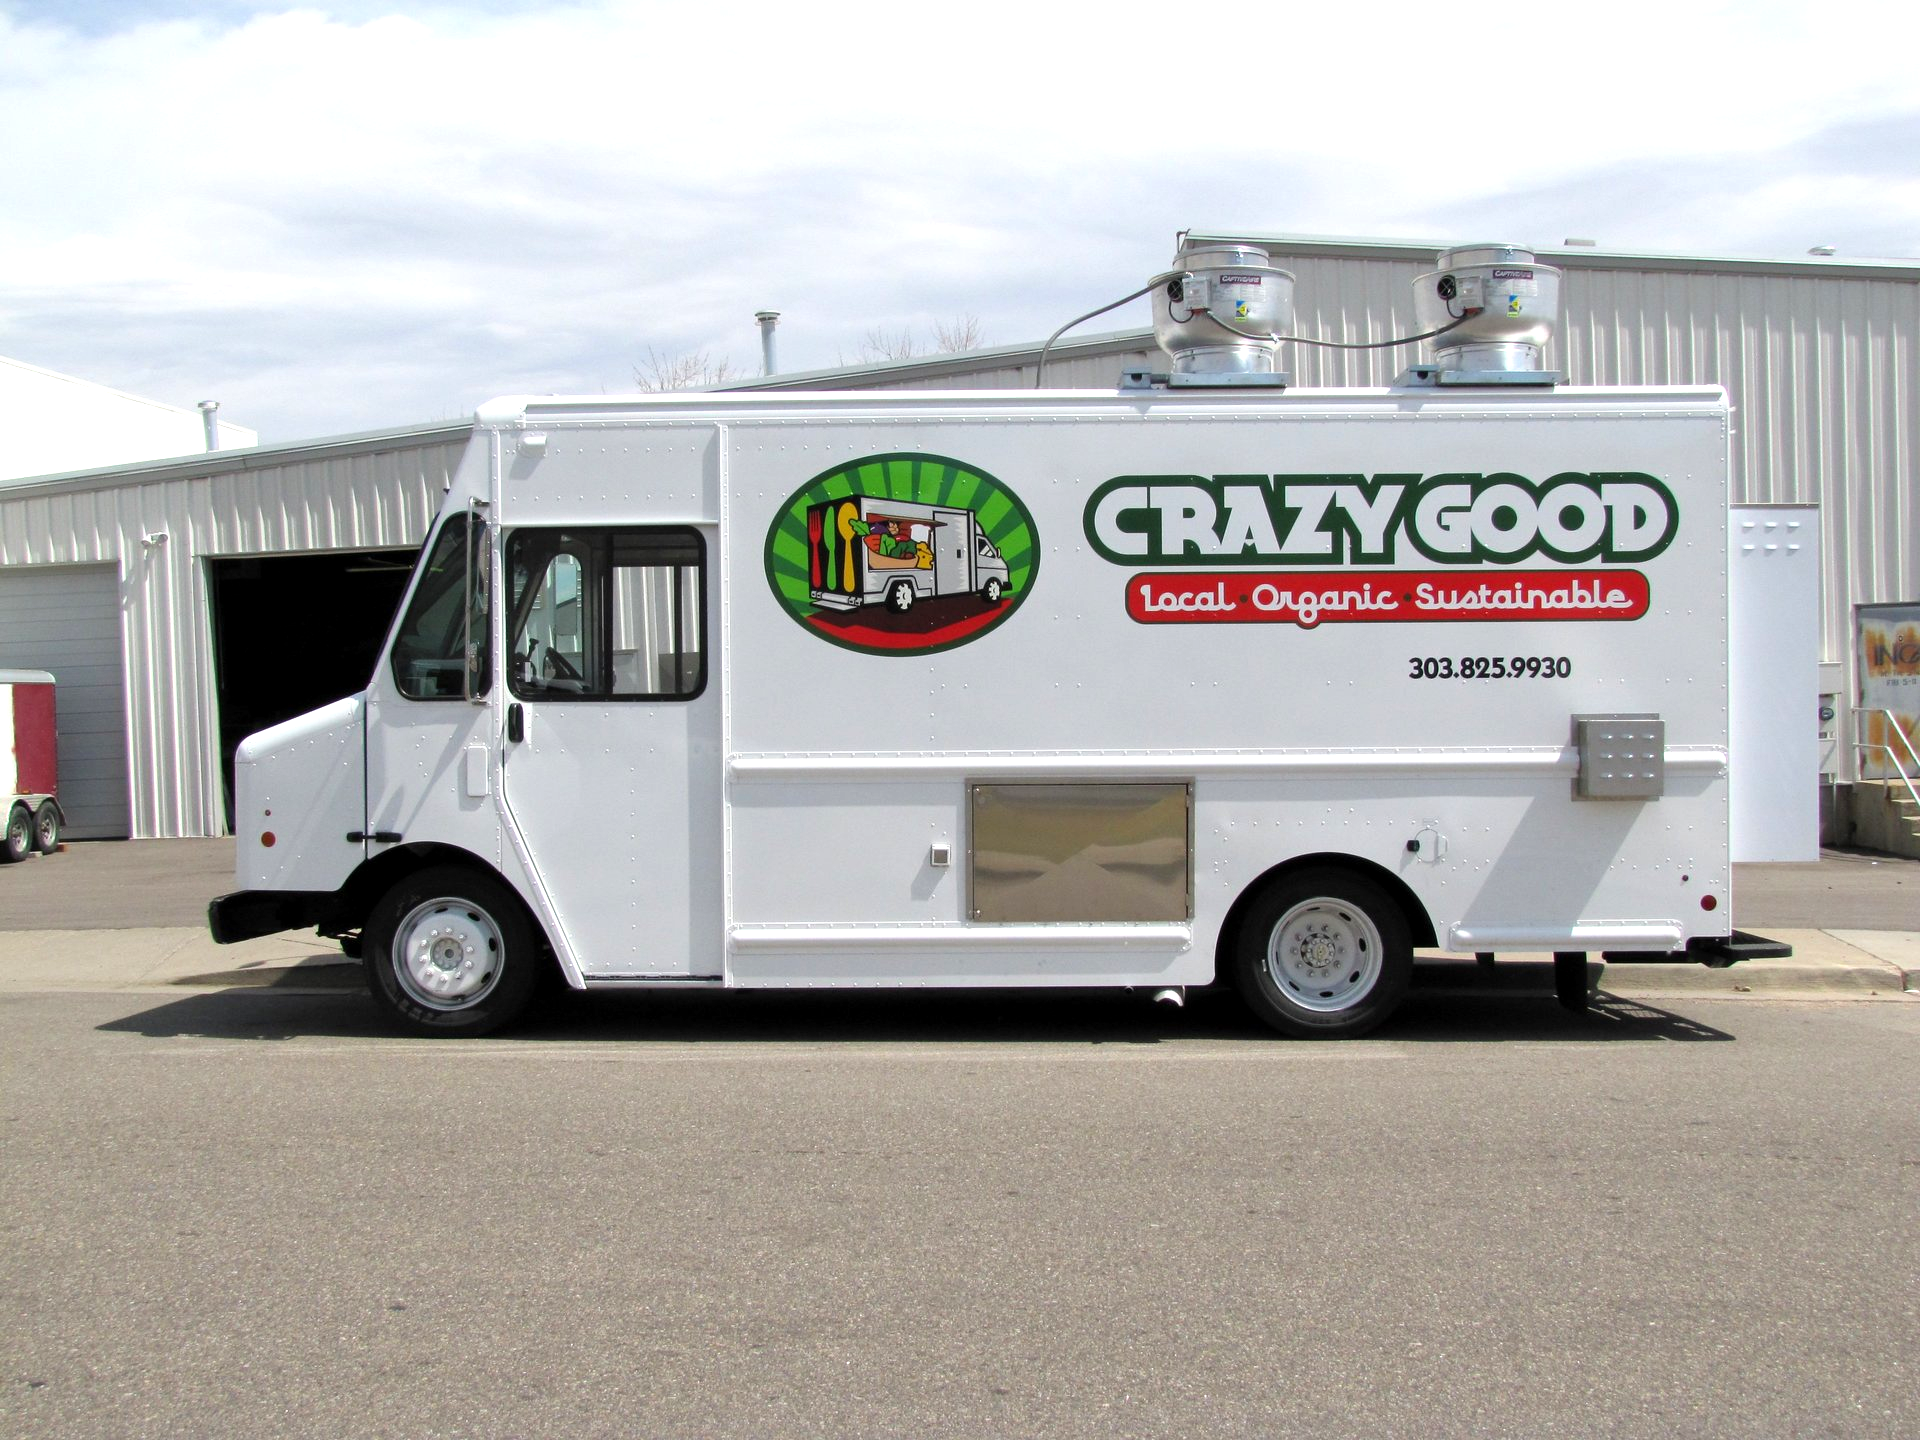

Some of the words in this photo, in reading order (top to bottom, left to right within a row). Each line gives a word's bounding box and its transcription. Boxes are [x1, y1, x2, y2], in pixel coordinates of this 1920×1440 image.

[1140, 582, 1236, 612] Local
[1252, 583, 1398, 624] Organic
[1415, 580, 1633, 610] Sustainable
[1409, 656, 1572, 679] 303.825.9930
